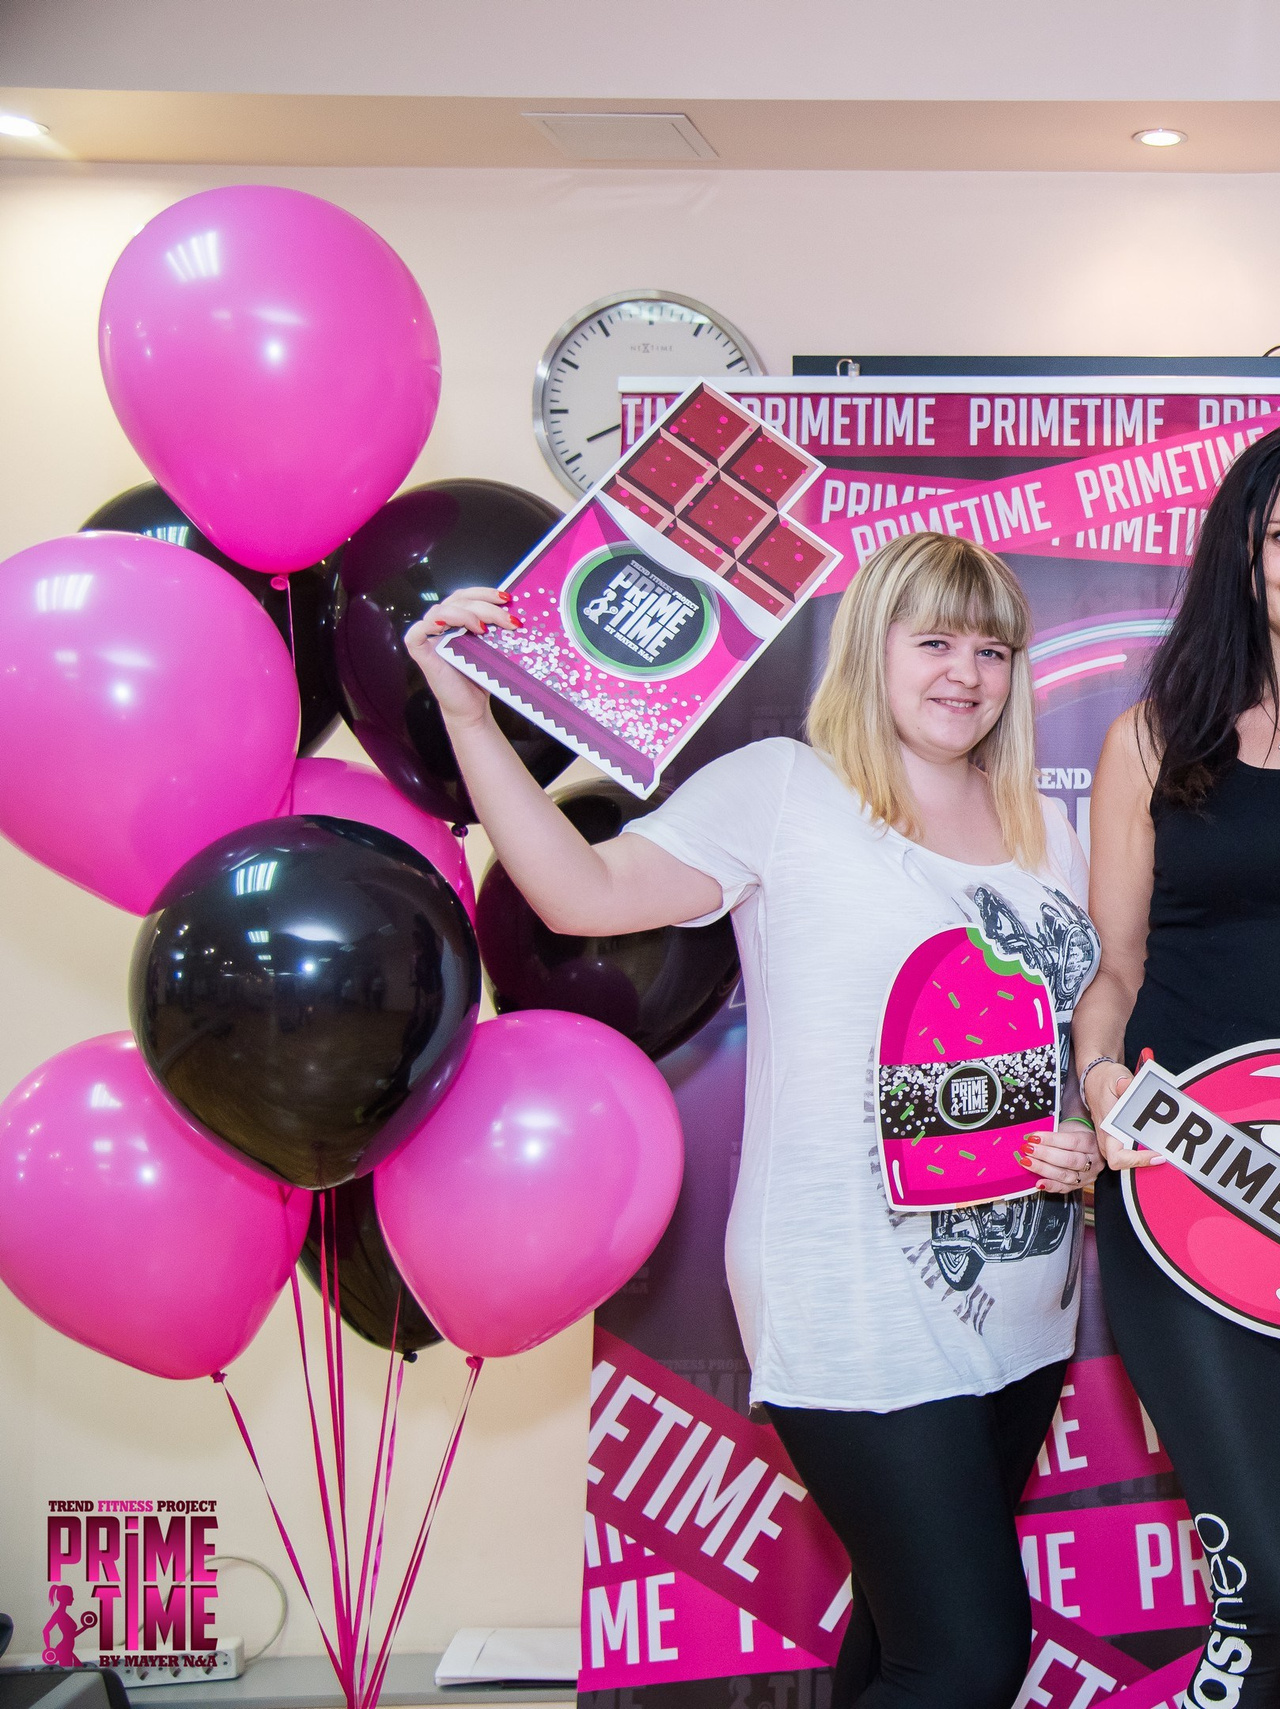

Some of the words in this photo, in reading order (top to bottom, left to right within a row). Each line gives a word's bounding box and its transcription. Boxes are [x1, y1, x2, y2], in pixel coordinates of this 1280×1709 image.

[622, 398, 669, 446] TI
[969, 398, 1166, 447] PRIMETIME
[608, 592, 676, 658] TIME
[672, 590, 700, 612] PROJECT
[603, 624, 617, 635] BY
[588, 1571, 679, 1669] ME
